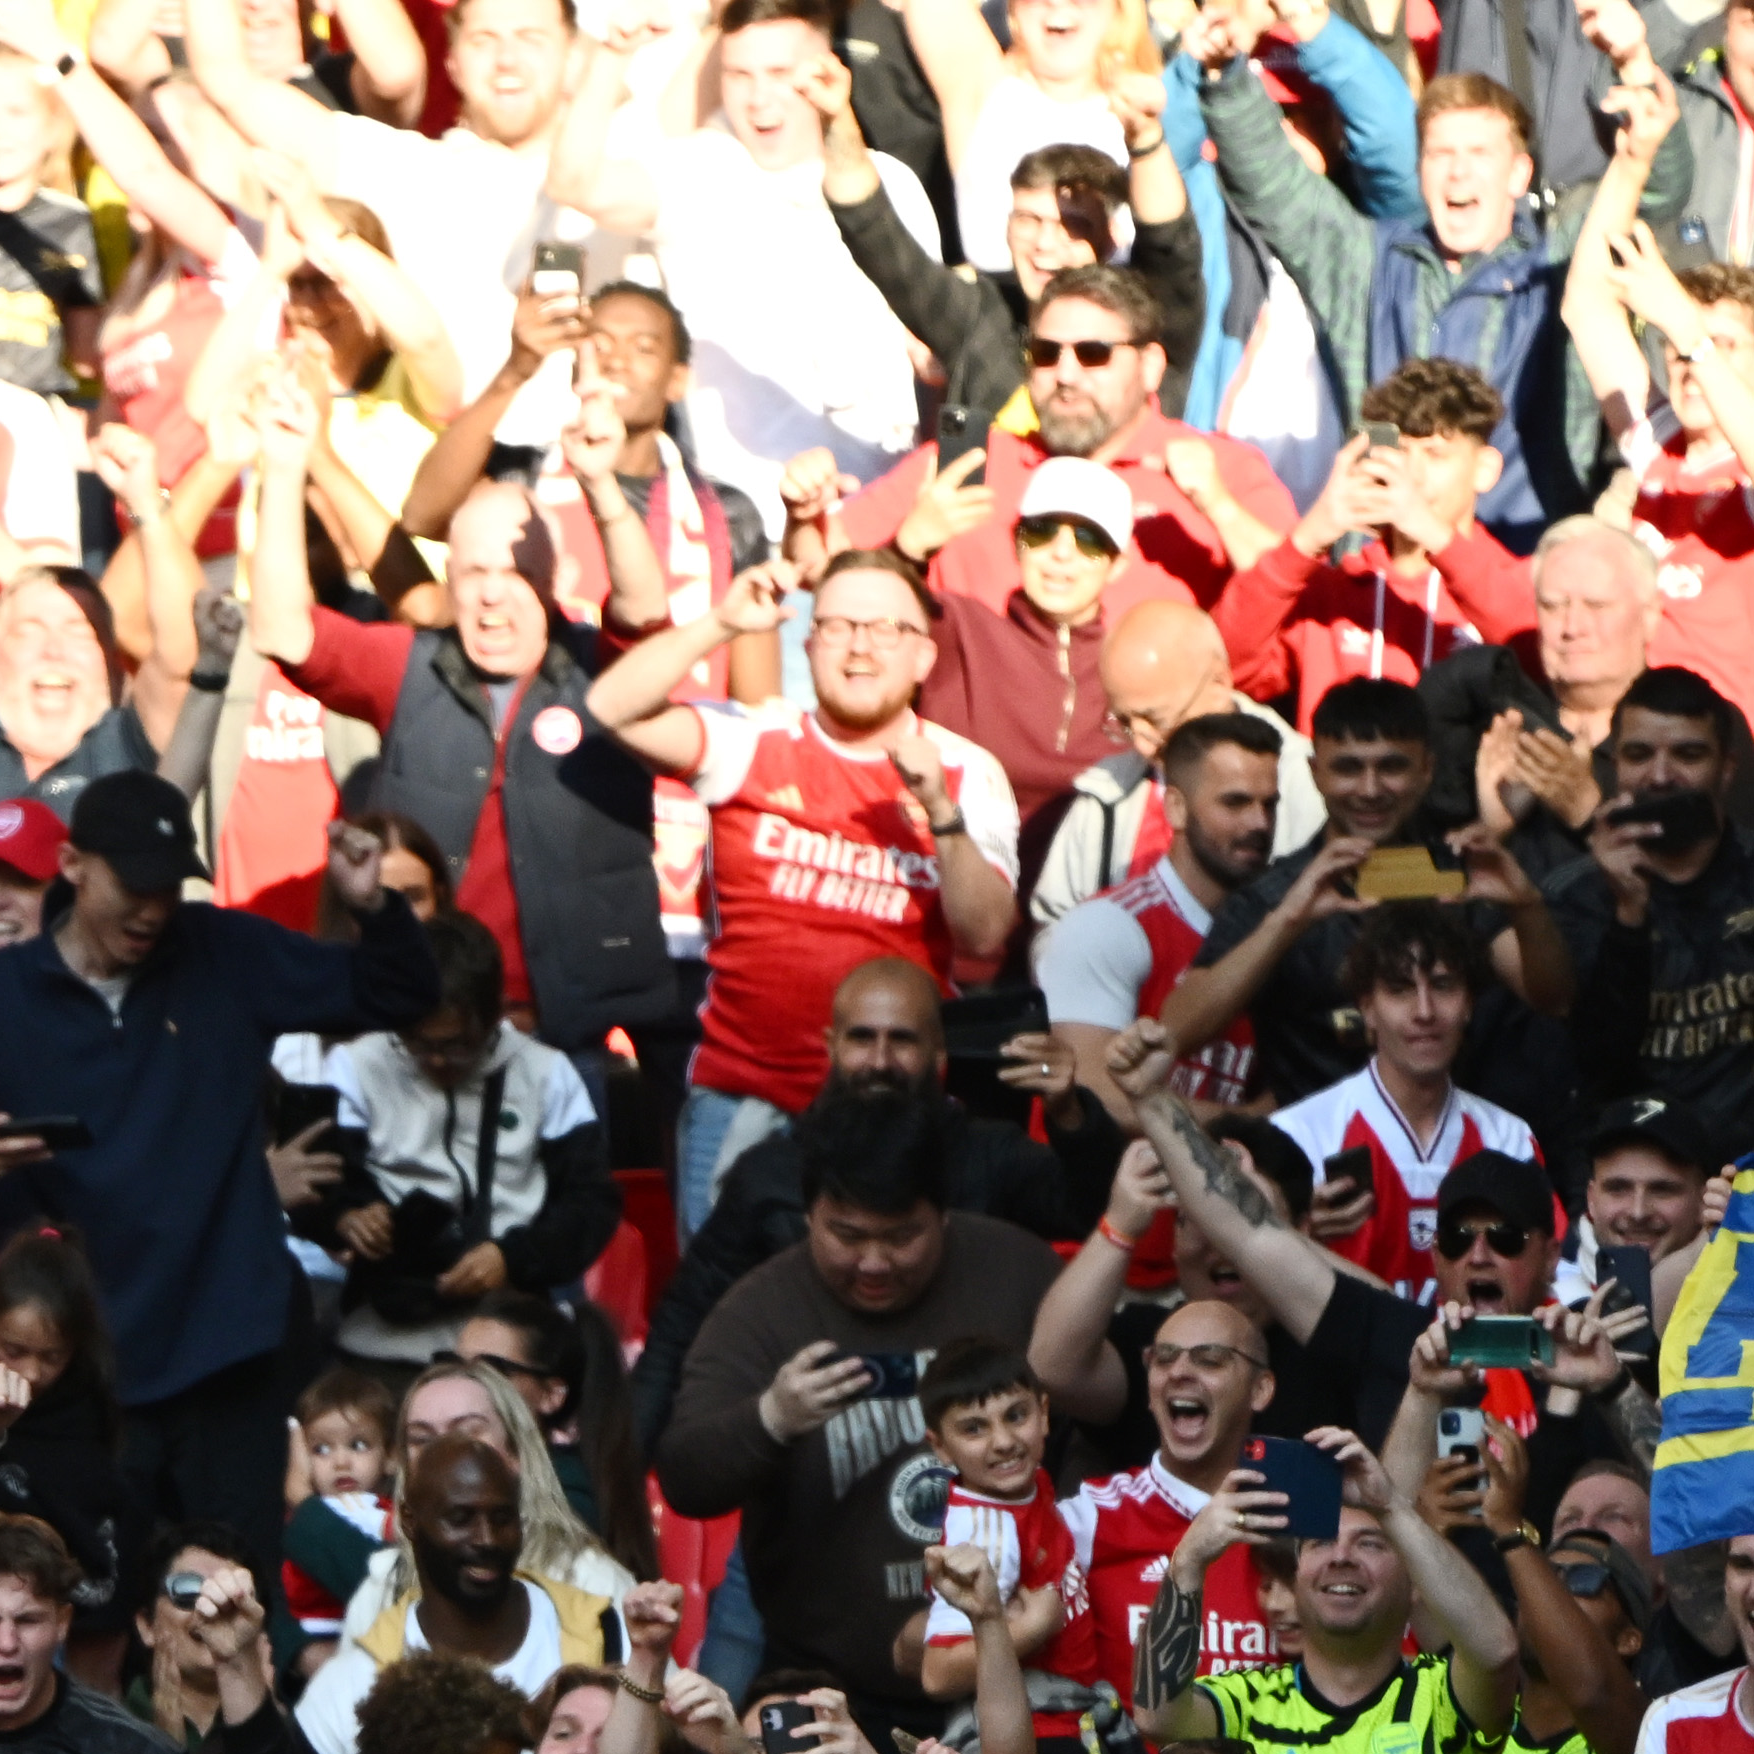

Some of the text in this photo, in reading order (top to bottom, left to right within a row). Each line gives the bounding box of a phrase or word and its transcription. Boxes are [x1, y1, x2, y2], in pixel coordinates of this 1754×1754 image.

[754, 811, 940, 888] Emirates
[771, 859, 910, 922] FLY BETTER
